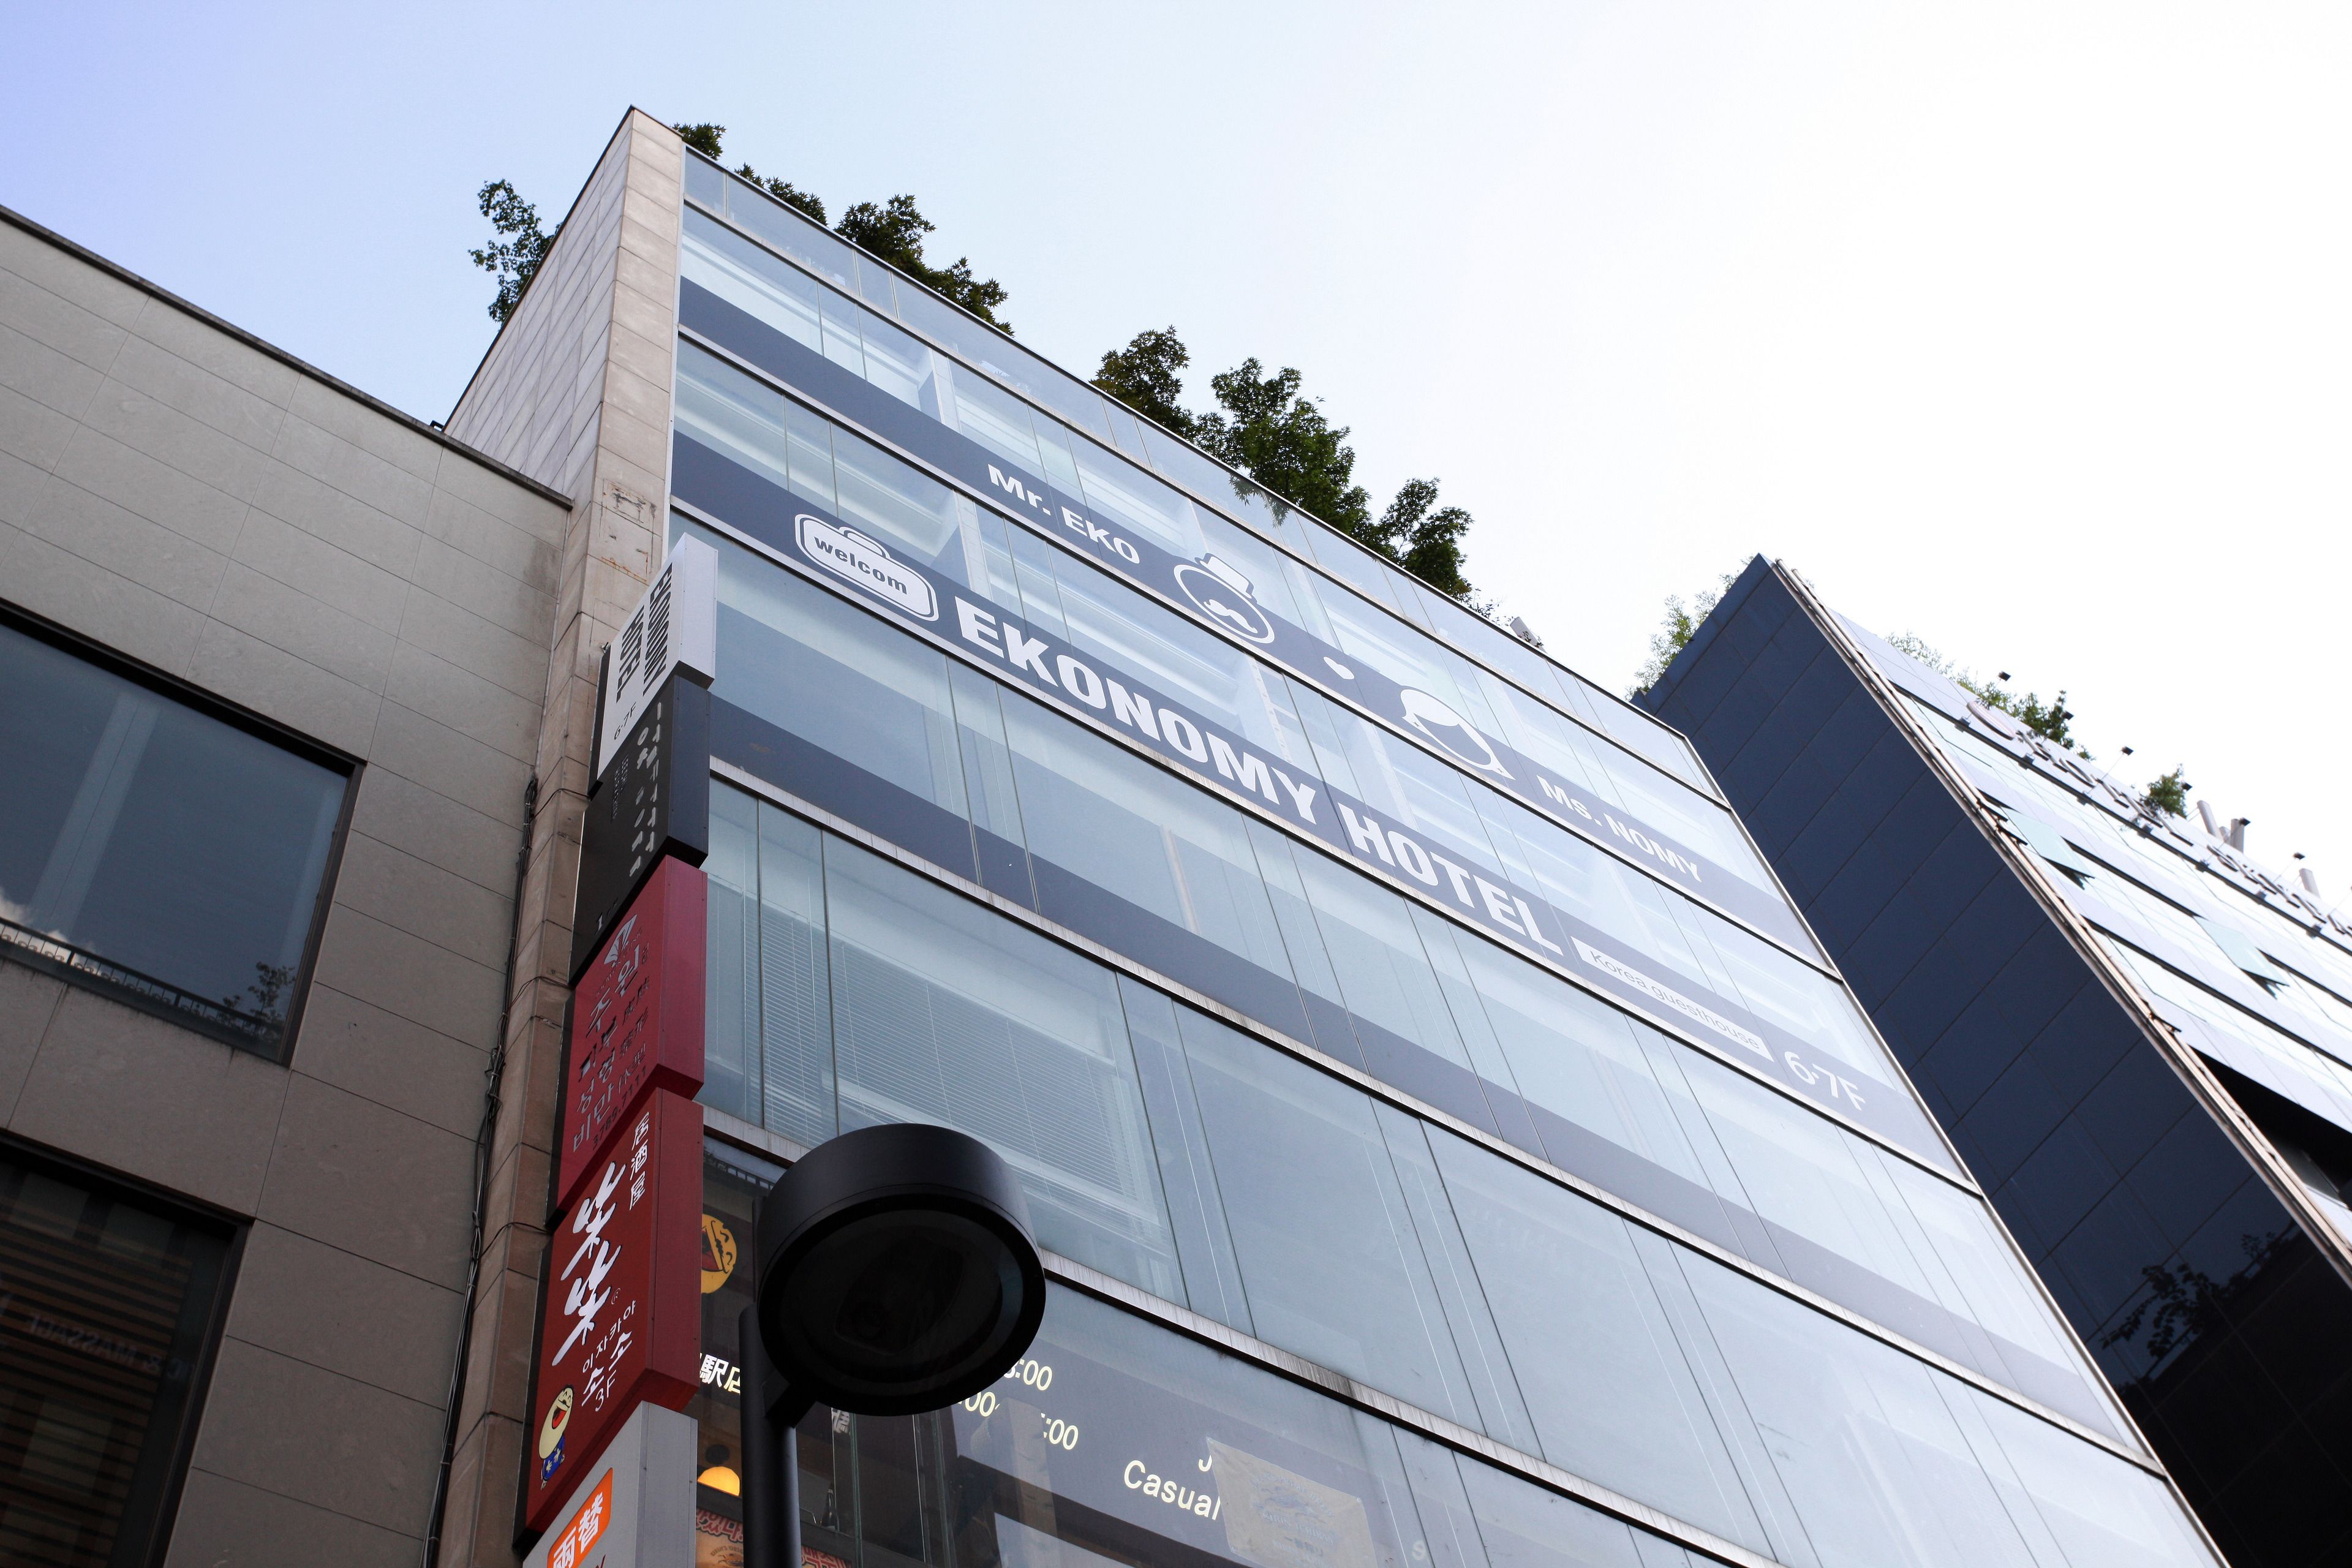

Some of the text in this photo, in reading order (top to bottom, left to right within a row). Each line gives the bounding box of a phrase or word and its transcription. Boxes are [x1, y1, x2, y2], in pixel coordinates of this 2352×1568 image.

[987, 463, 1140, 565] Mr. EKO
[813, 535, 910, 595] welcom
[616, 604, 645, 704] HOTEL
[643, 562, 673, 697] EKONOMY
[955, 596, 1564, 956] EKONOMY HOTEL
[1538, 776, 1703, 884] Ms. NOMY
[586, 944, 641, 1036] 주원
[1588, 948, 1762, 1052] Korea guesthouse
[577, 1048, 616, 1113] 성형
[578, 1018, 618, 1083] 피부
[573, 1082, 614, 1153] 비만
[629, 1110, 650, 1211] 居酒屋
[581, 1331, 633, 1408] 소소
[582, 1299, 636, 1374] 이자카야
[699, 1352, 740, 1395] 駅店
[595, 1368, 617, 1412] 3F
[1123, 1459, 1222, 1522] Casual
